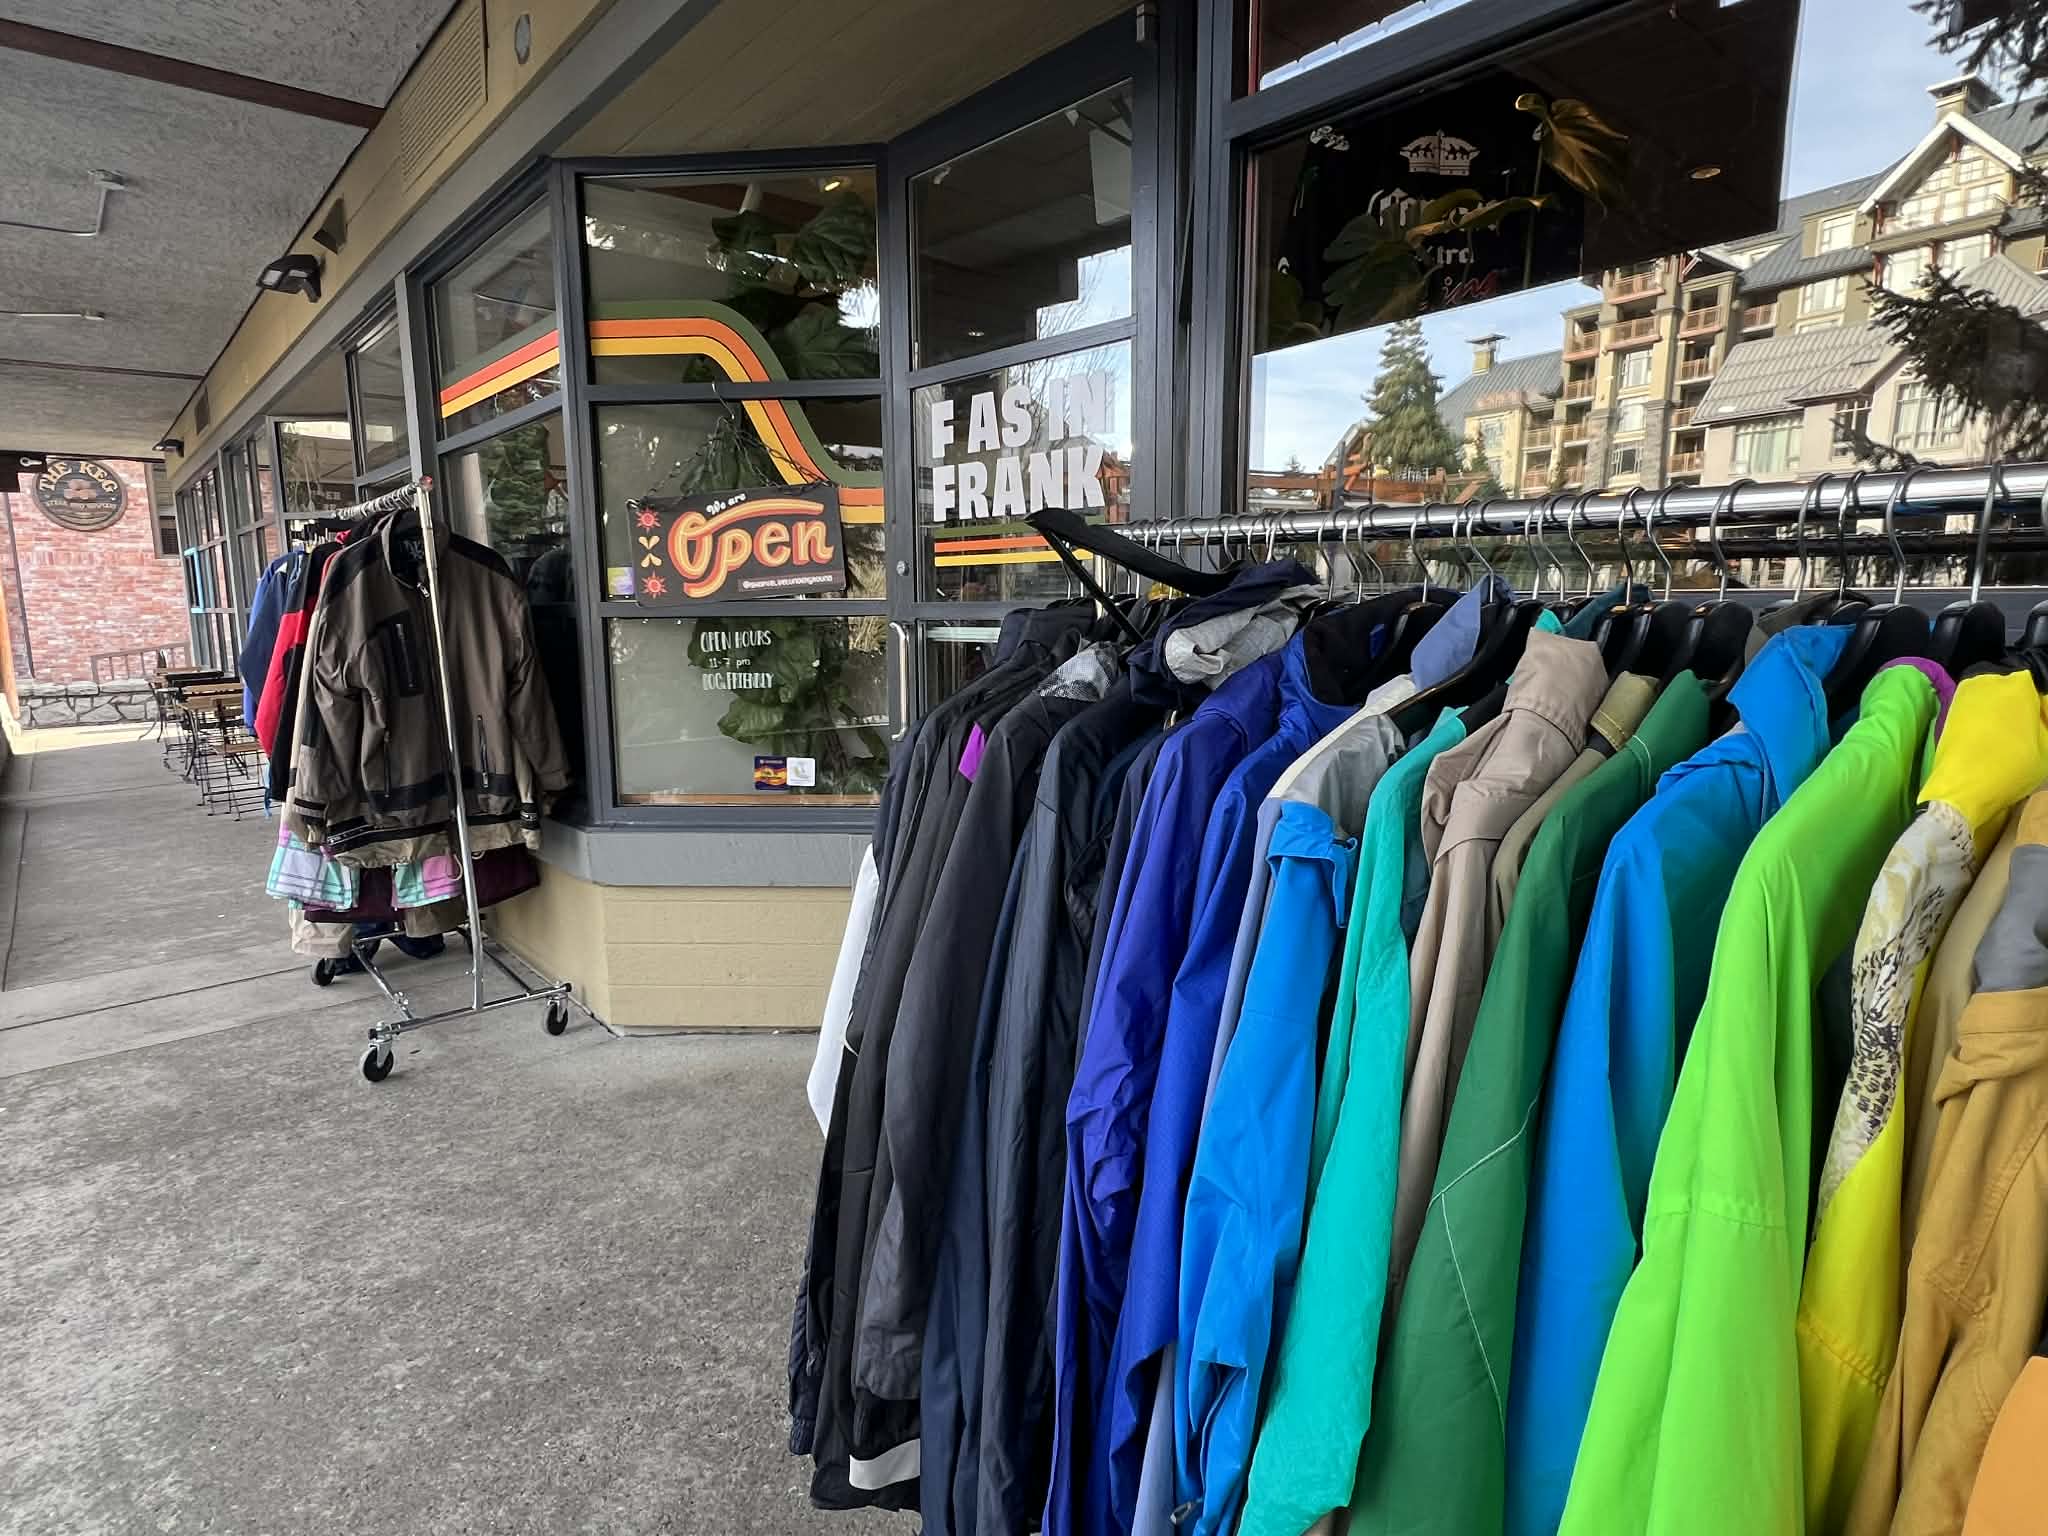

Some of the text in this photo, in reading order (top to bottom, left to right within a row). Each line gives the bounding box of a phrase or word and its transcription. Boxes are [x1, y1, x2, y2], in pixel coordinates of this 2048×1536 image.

[931, 369, 1109, 458] F AS IN
[39, 461, 119, 493] THE KEG
[932, 445, 1106, 522] FRANK
[706, 494, 746, 515] We are
[667, 498, 834, 598] Open
[700, 629, 772, 652] OPEN HOURS
[736, 658, 751, 669] pm
[702, 671, 774, 690] DOG FRIENDLY
